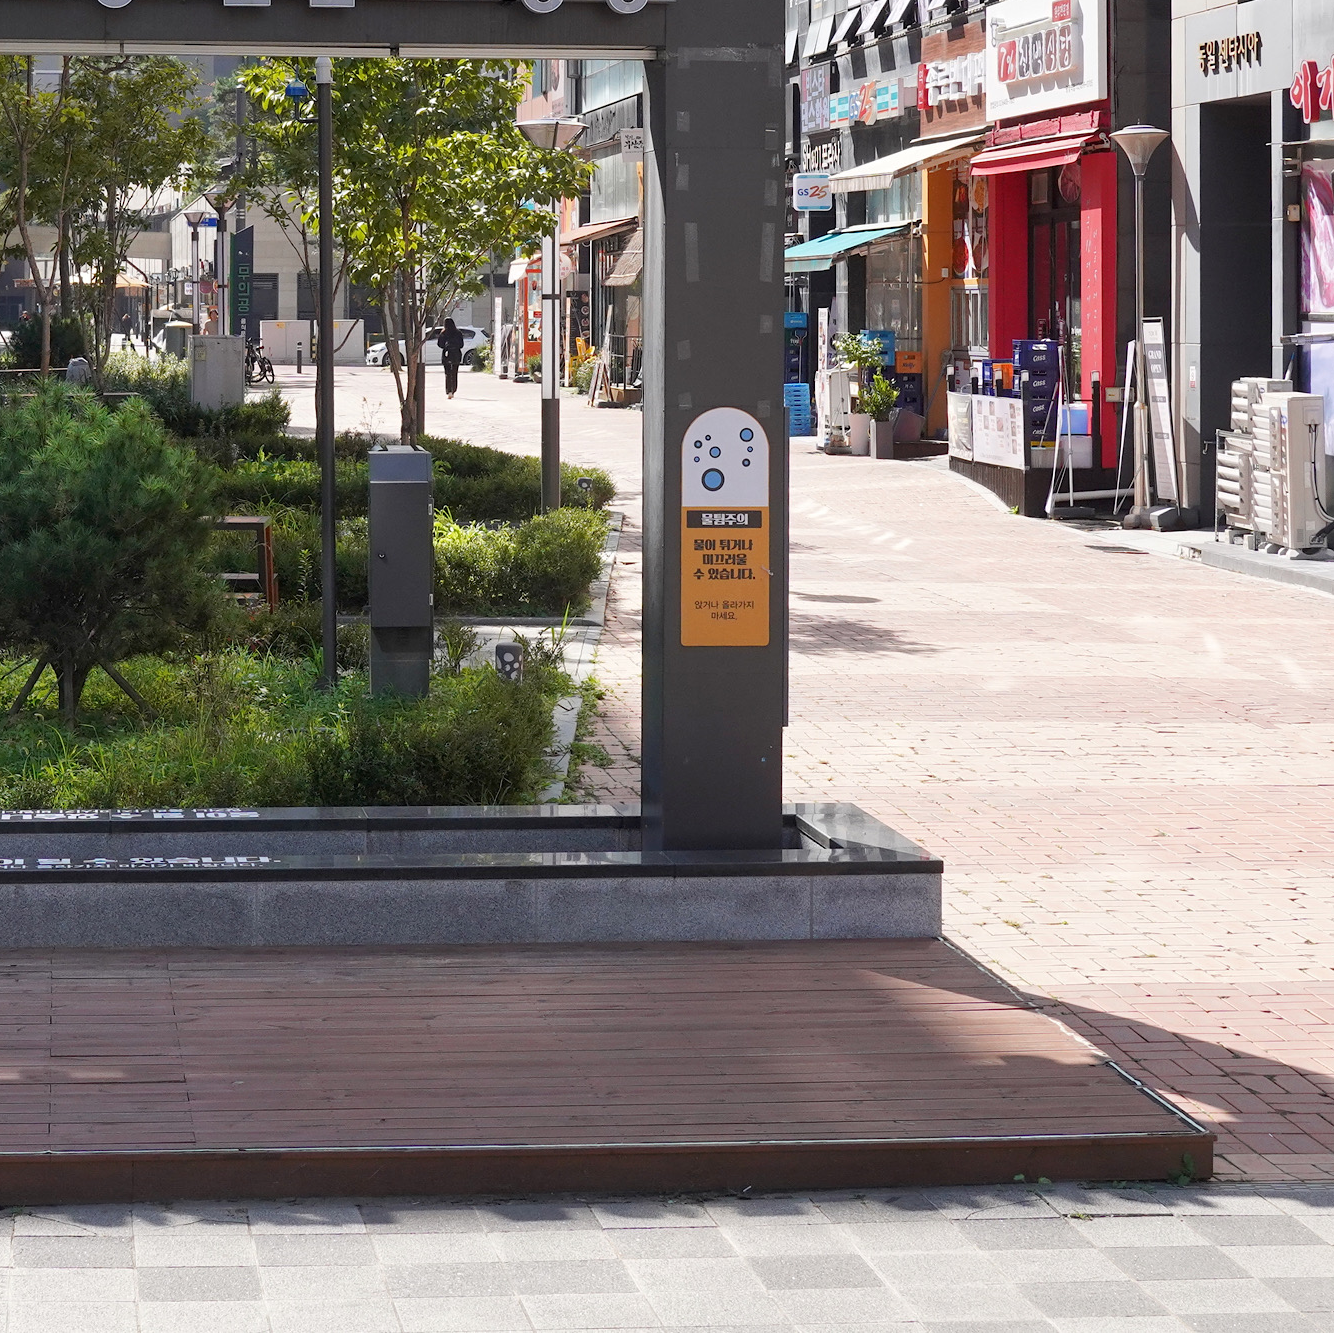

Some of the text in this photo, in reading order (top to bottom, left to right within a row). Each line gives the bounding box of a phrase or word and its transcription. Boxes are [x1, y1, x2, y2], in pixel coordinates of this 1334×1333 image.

[1000, 49, 1014, 81] 7%
[849, 81, 876, 125] GS25
[798, 185, 829, 199] GS25
[1150, 364, 1162, 374] OPEN
[694, 539, 753, 550] 물이 튀거나
[703, 554, 747, 565] 미끄러울
[693, 568, 755, 579] 수 있습니다.
[695, 601, 754, 609] 앉거나 올라가지
[711, 612, 737, 620] 마세요.
[130, 856, 281, 864] 있습니다.
